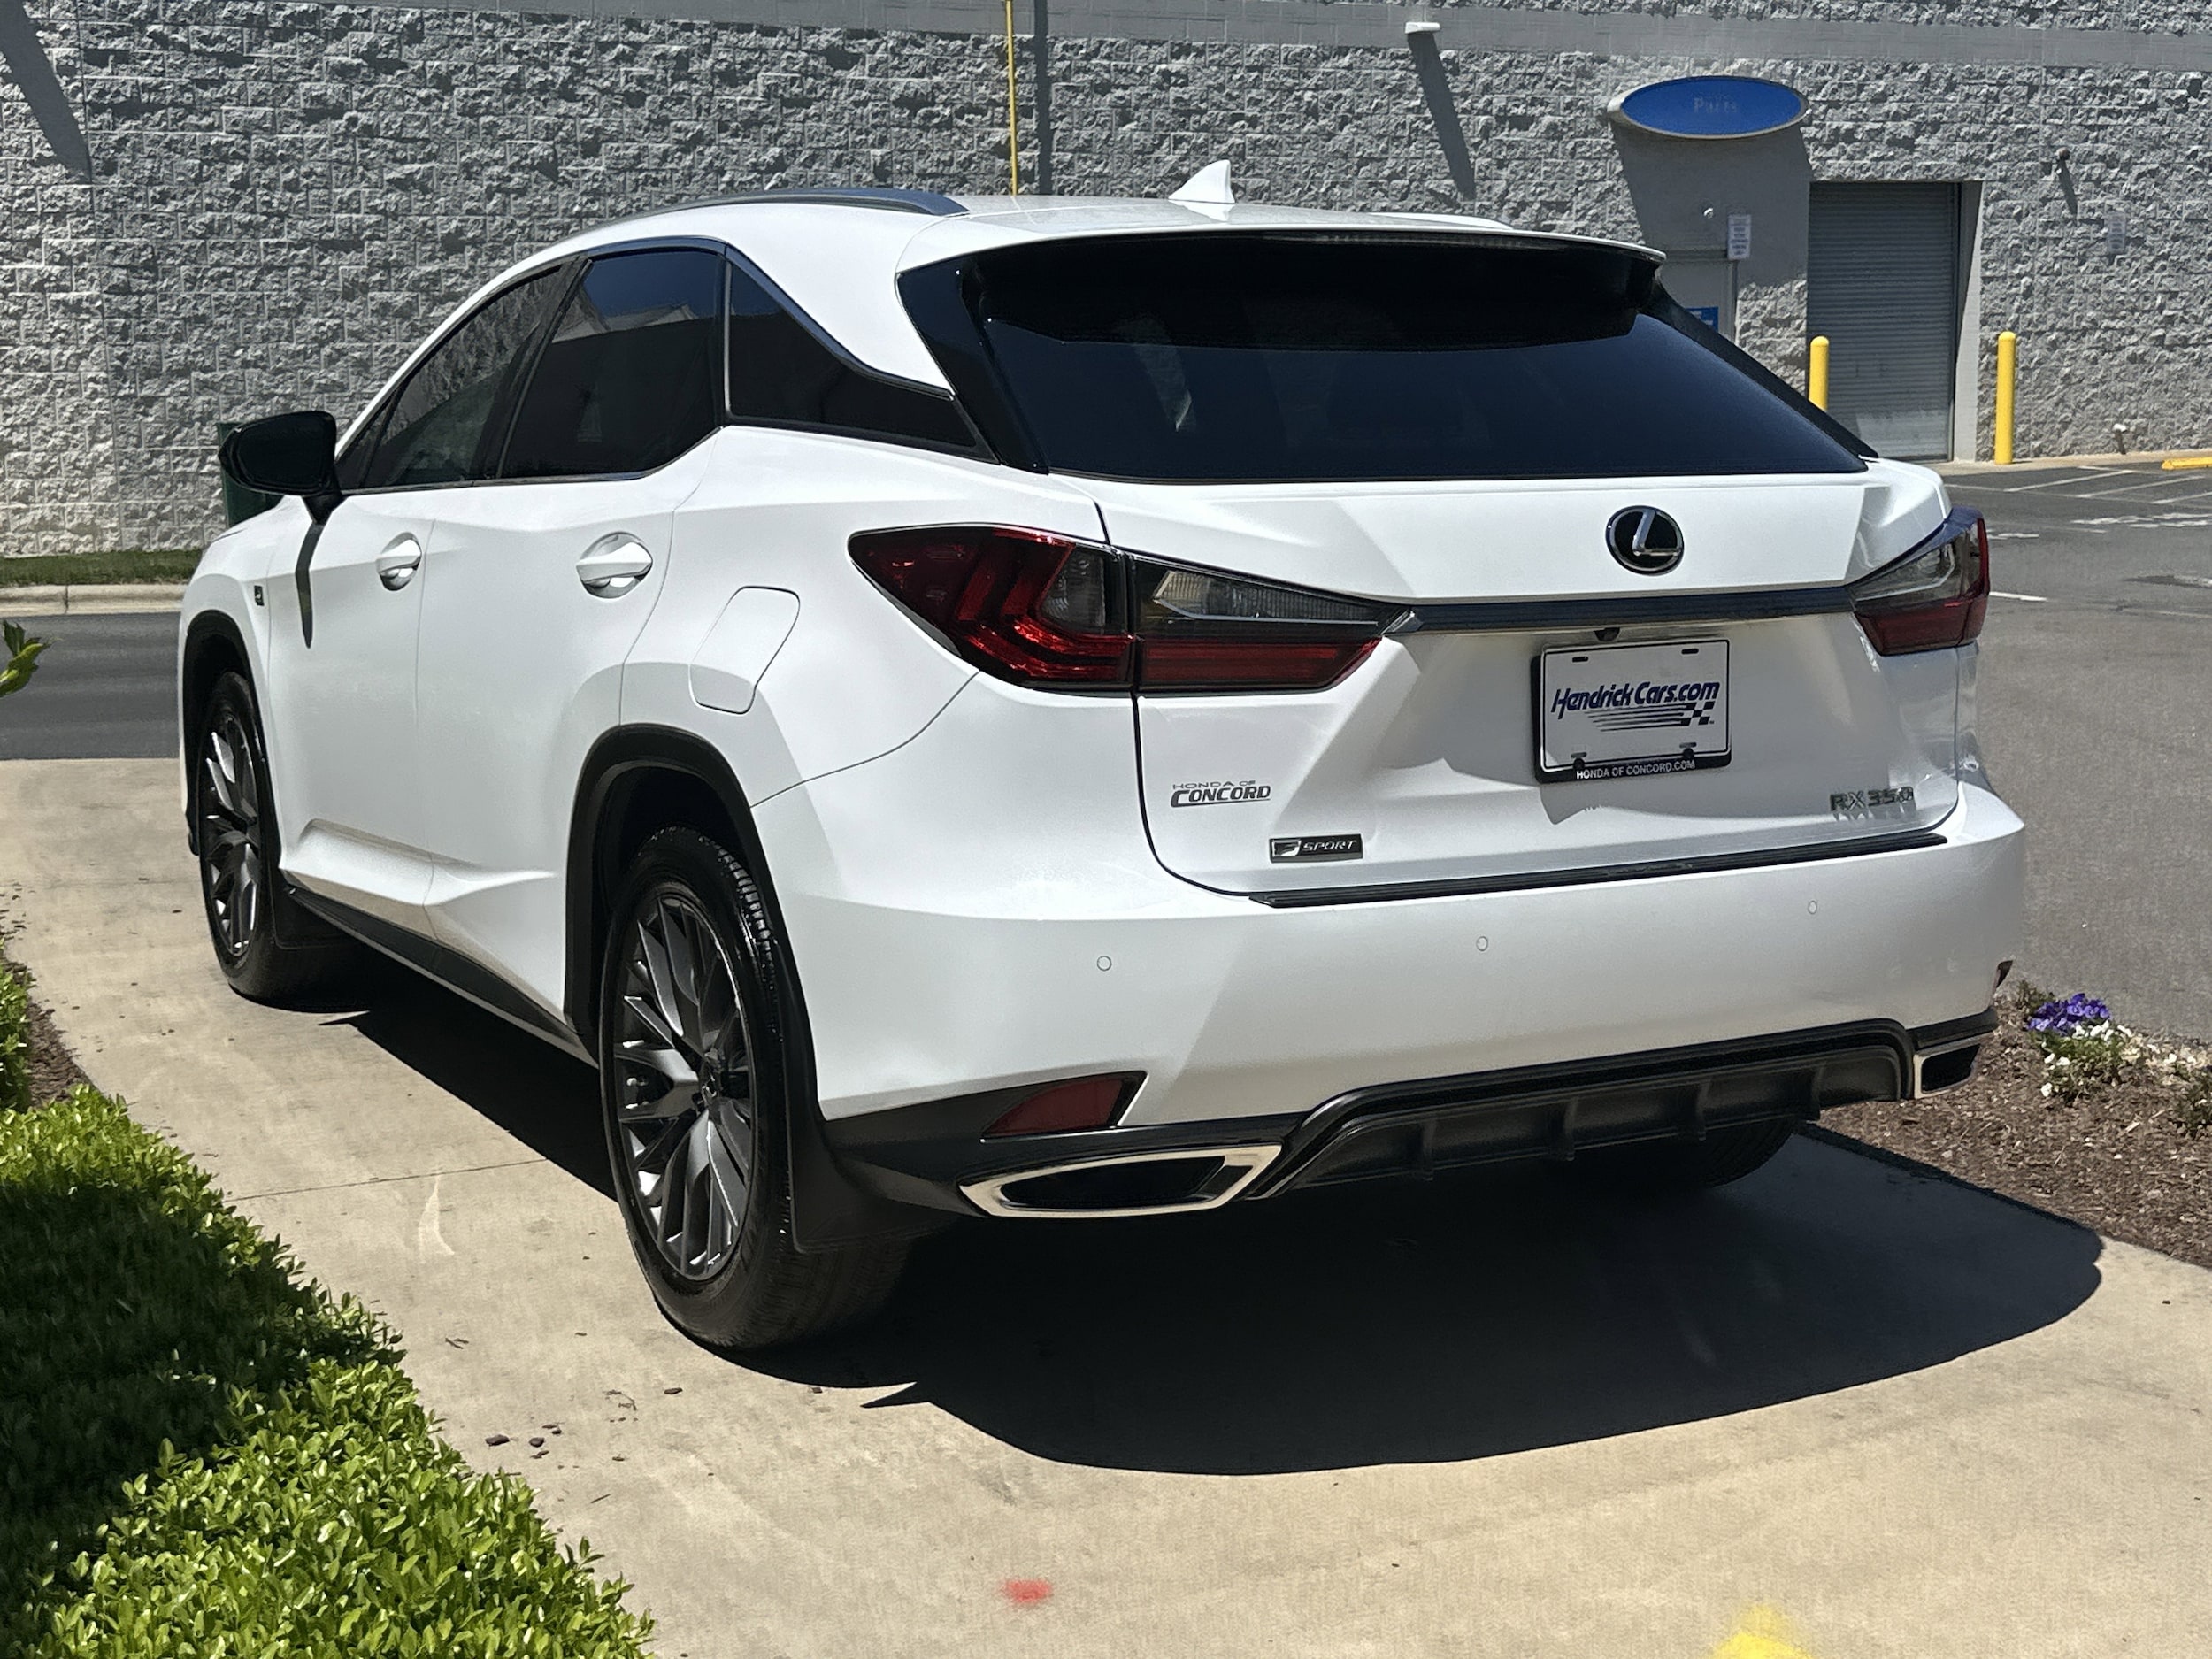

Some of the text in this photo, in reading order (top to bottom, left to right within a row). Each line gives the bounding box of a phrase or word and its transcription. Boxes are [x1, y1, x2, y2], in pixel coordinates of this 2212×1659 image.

[1550, 681, 1720, 720] Hendrick Cars.com
[1576, 759, 1696, 780] HONDA OF CONCORD.COM
[1172, 780, 1235, 790] HONDA
[1170, 785, 1271, 808] CONCORD
[1302, 839, 1357, 851] SPORT
